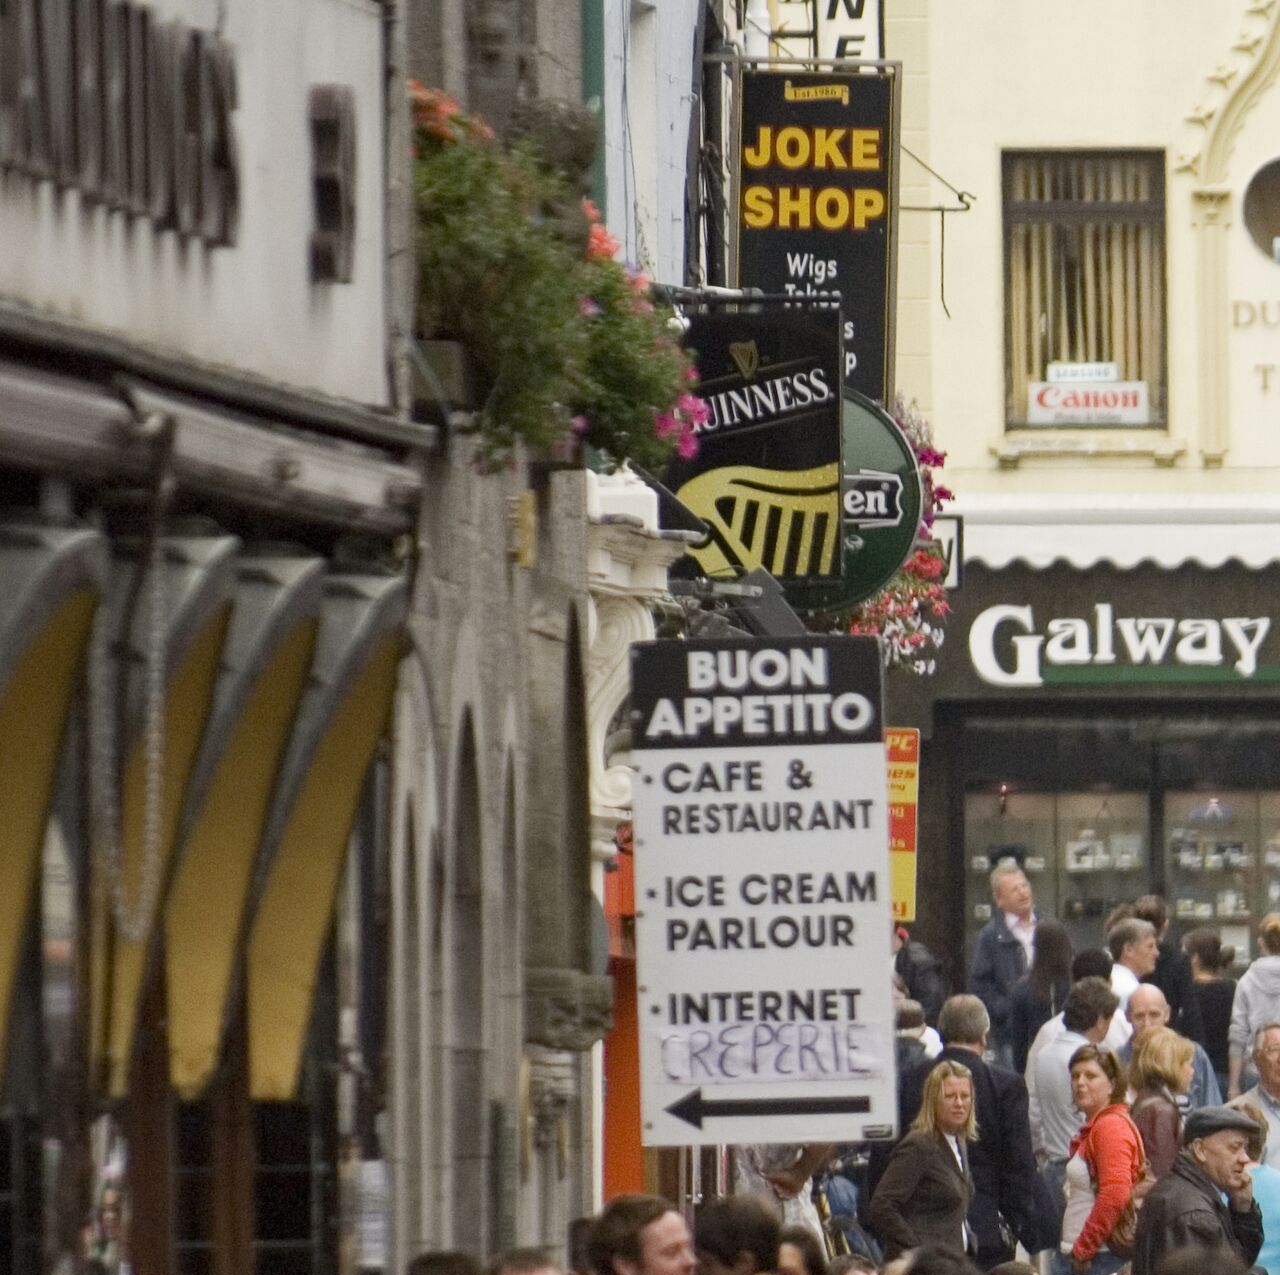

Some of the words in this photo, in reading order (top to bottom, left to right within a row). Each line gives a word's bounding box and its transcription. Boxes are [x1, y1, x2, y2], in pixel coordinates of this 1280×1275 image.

[744, 125, 882, 170] JOKE
[743, 184, 885, 230] SHOP
[786, 252, 838, 285] Wigs
[1037, 386, 1140, 409] Canon
[969, 603, 1270, 688] Galway
[688, 648, 829, 690] BUON
[645, 692, 874, 737] APPETITO
[662, 761, 763, 794] CAFE
[786, 758, 813, 791] &
[662, 799, 874, 836] RESTAURANT
[665, 874, 726, 908] ICE
[739, 871, 878, 907] CREAM
[666, 915, 855, 952] PARLOUR
[668, 988, 862, 1025] INTERNET
